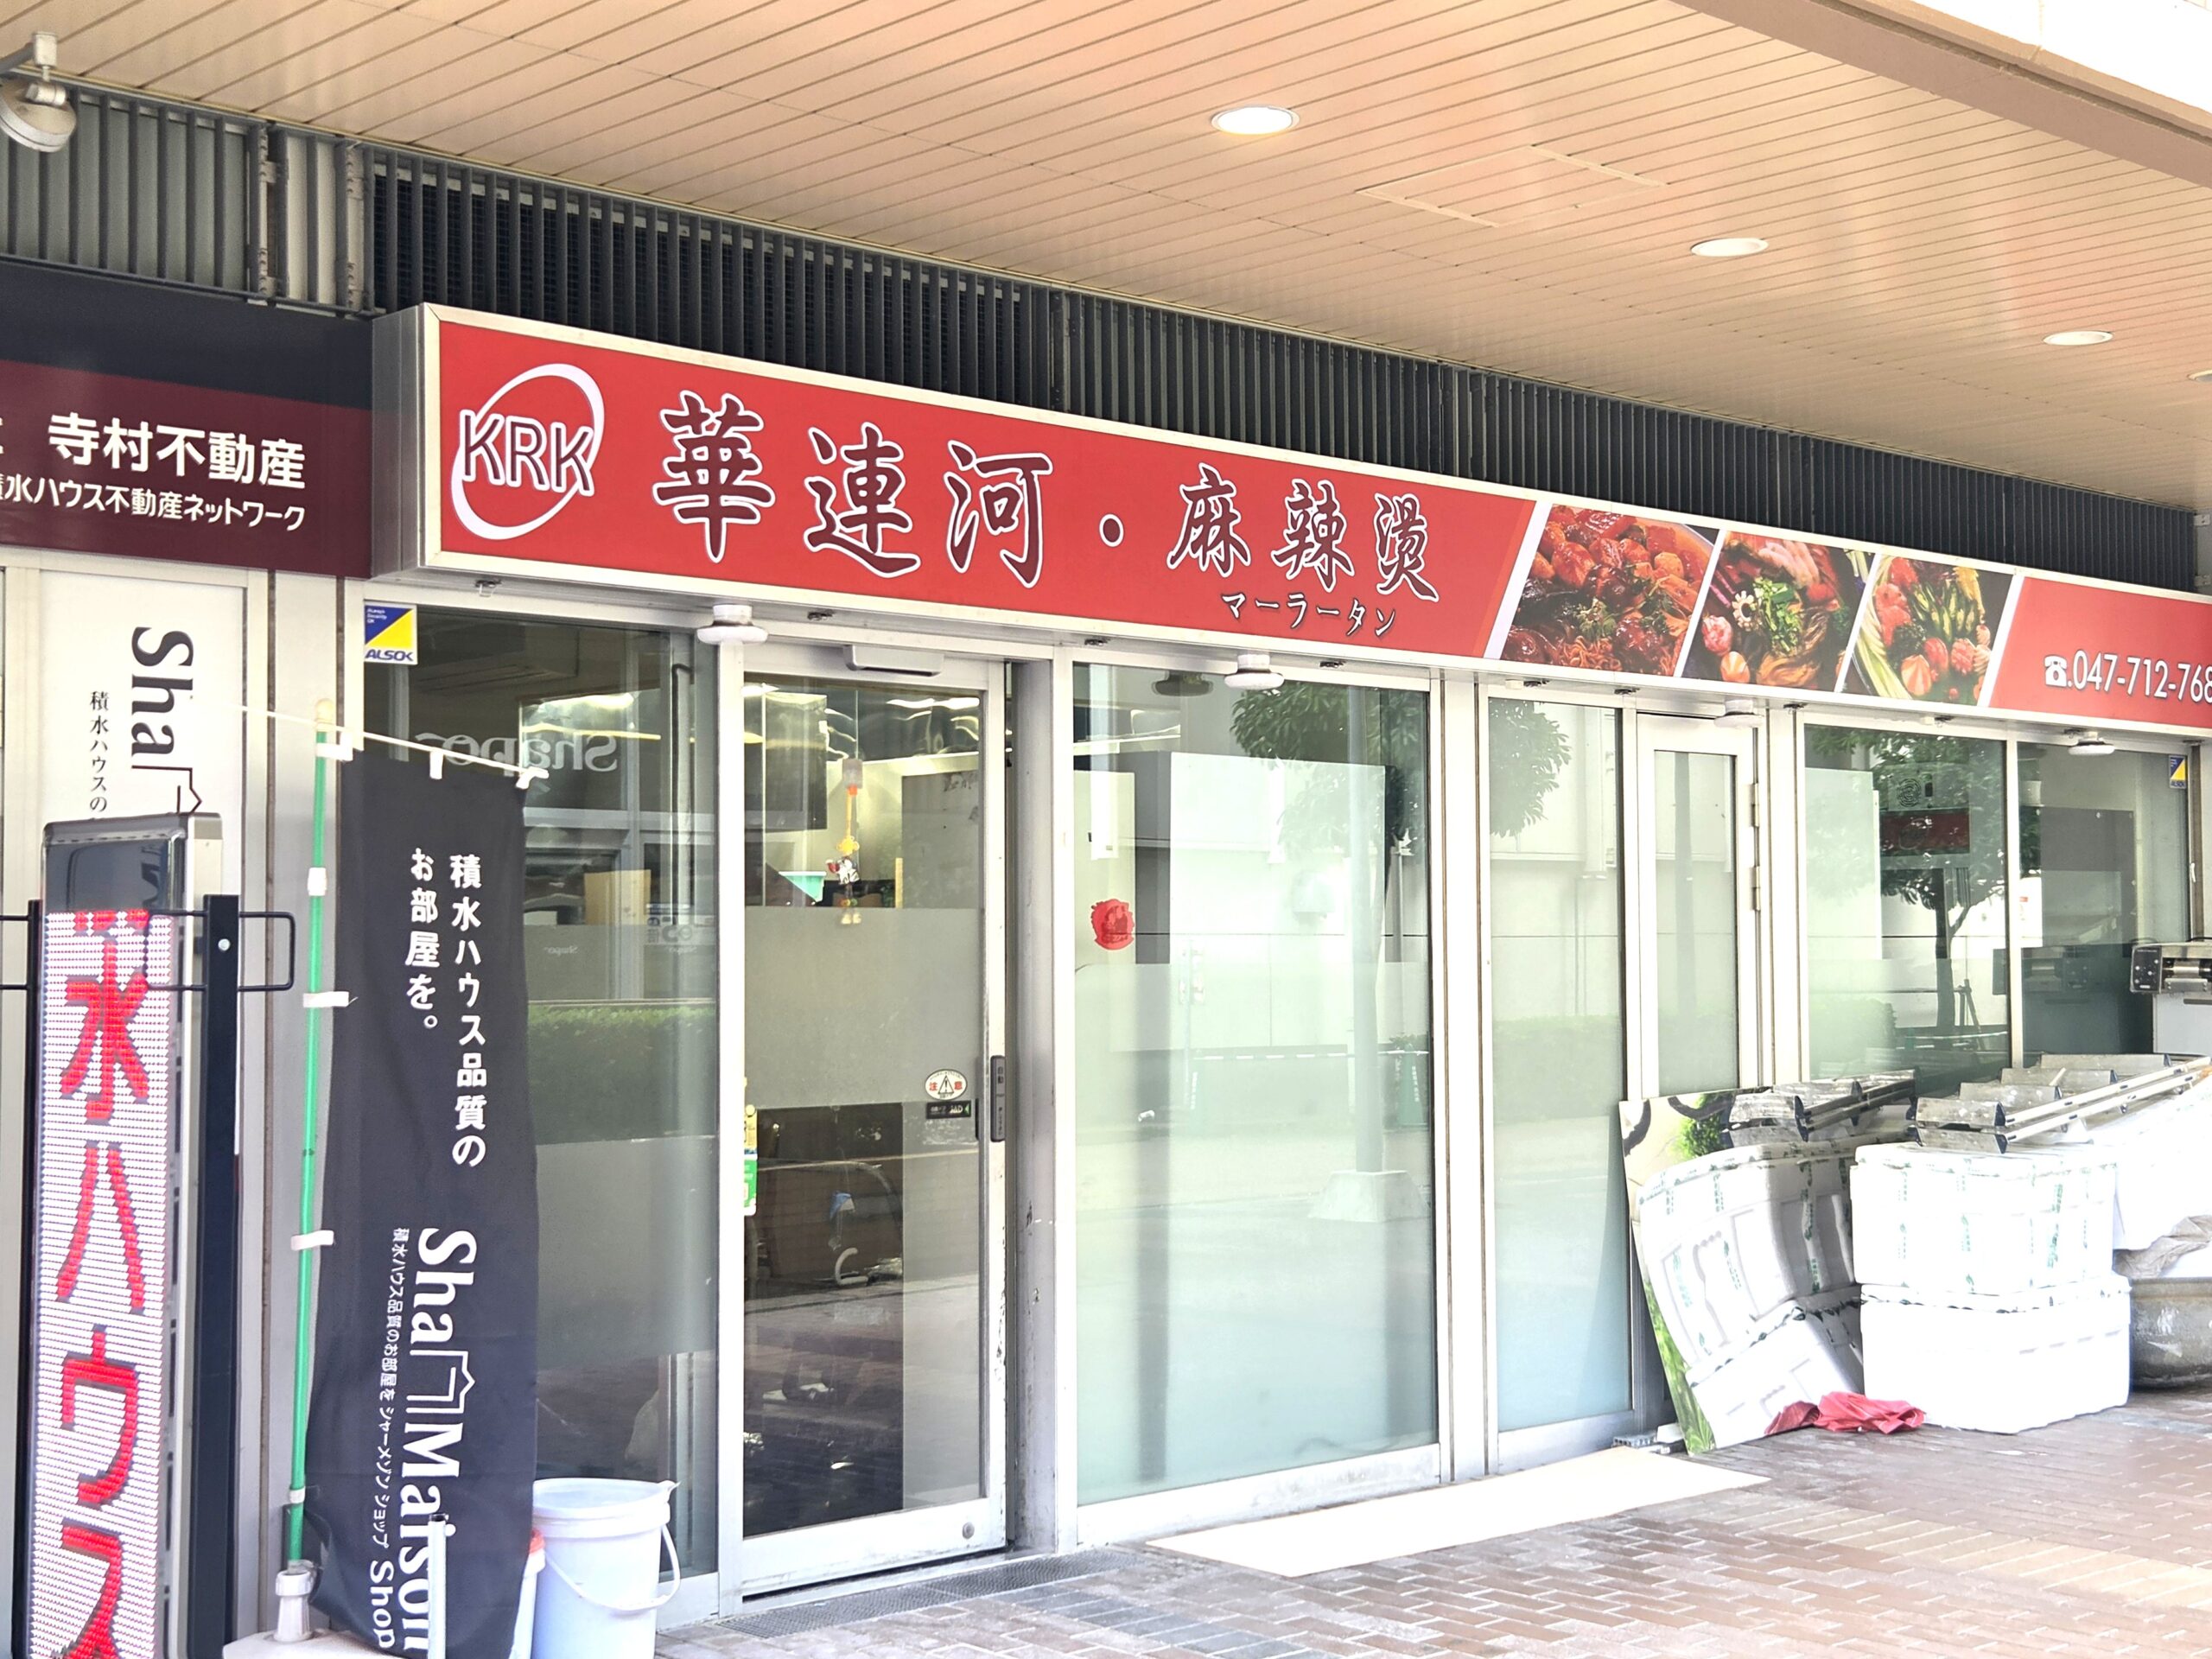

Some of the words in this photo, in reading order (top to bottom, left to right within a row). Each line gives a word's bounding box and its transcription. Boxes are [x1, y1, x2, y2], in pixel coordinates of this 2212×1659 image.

[48, 411, 306, 489] 寺村不動産
[459, 409, 594, 498] KRK
[0, 473, 306, 531] 水ハウス不動産ネットワーク
[365, 648, 414, 662] ALSOK
[1221, 591, 1396, 638] マーラータン
[131, 626, 194, 757] Sha
[89, 690, 111, 813] 積水ハウスの
[404, 848, 441, 1028] お部屋を。
[449, 854, 487, 1167] 積水ハウス品質の
[52, 909, 151, 1659] 水ハウス
[370, 1560, 396, 1649] Shop
